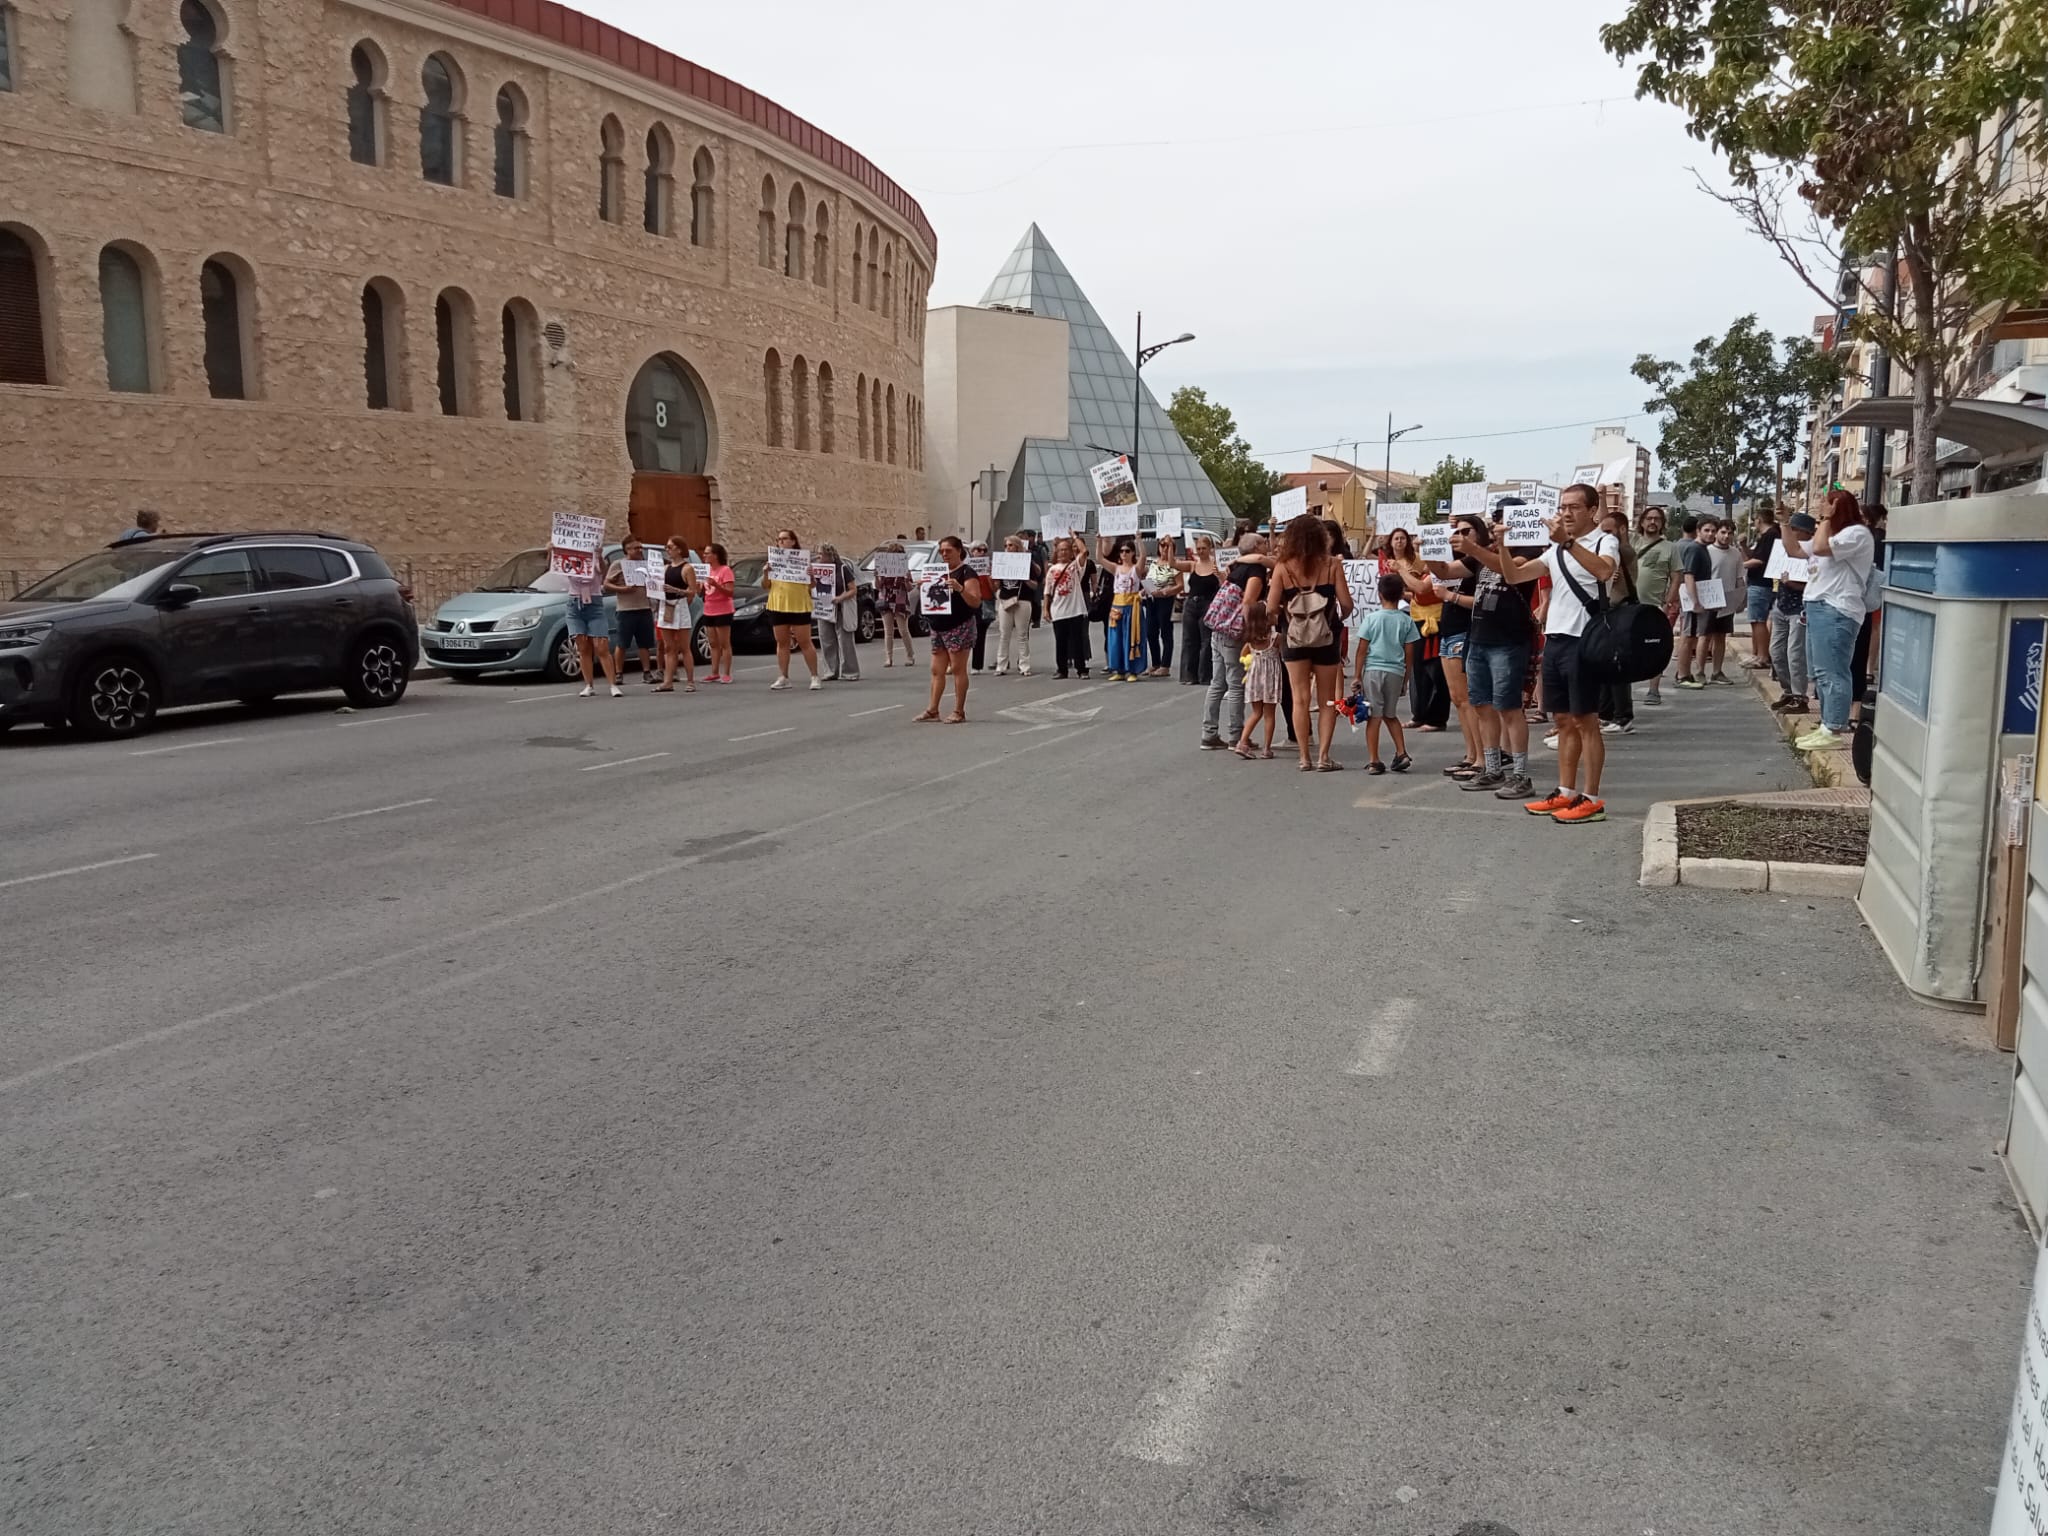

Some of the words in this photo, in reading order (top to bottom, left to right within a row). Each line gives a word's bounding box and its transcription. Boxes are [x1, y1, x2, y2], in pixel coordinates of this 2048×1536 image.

[656, 401, 668, 428] 8
[1440, 500, 1447, 509] P
[1508, 508, 1540, 520] ¿PAGAS
[1506, 520, 1526, 529] PARA
[1527, 520, 1544, 529] VER
[1421, 527, 1445, 538] ¿PAGAS
[1508, 530, 1541, 541] SUFRIR?
[1436, 537, 1449, 546] VER
[1422, 547, 1447, 556] SUFRIR?
[813, 568, 833, 577] STOP
[463, 640, 478, 649] FXL
[2024, 1482, 2048, 1536] Salu
